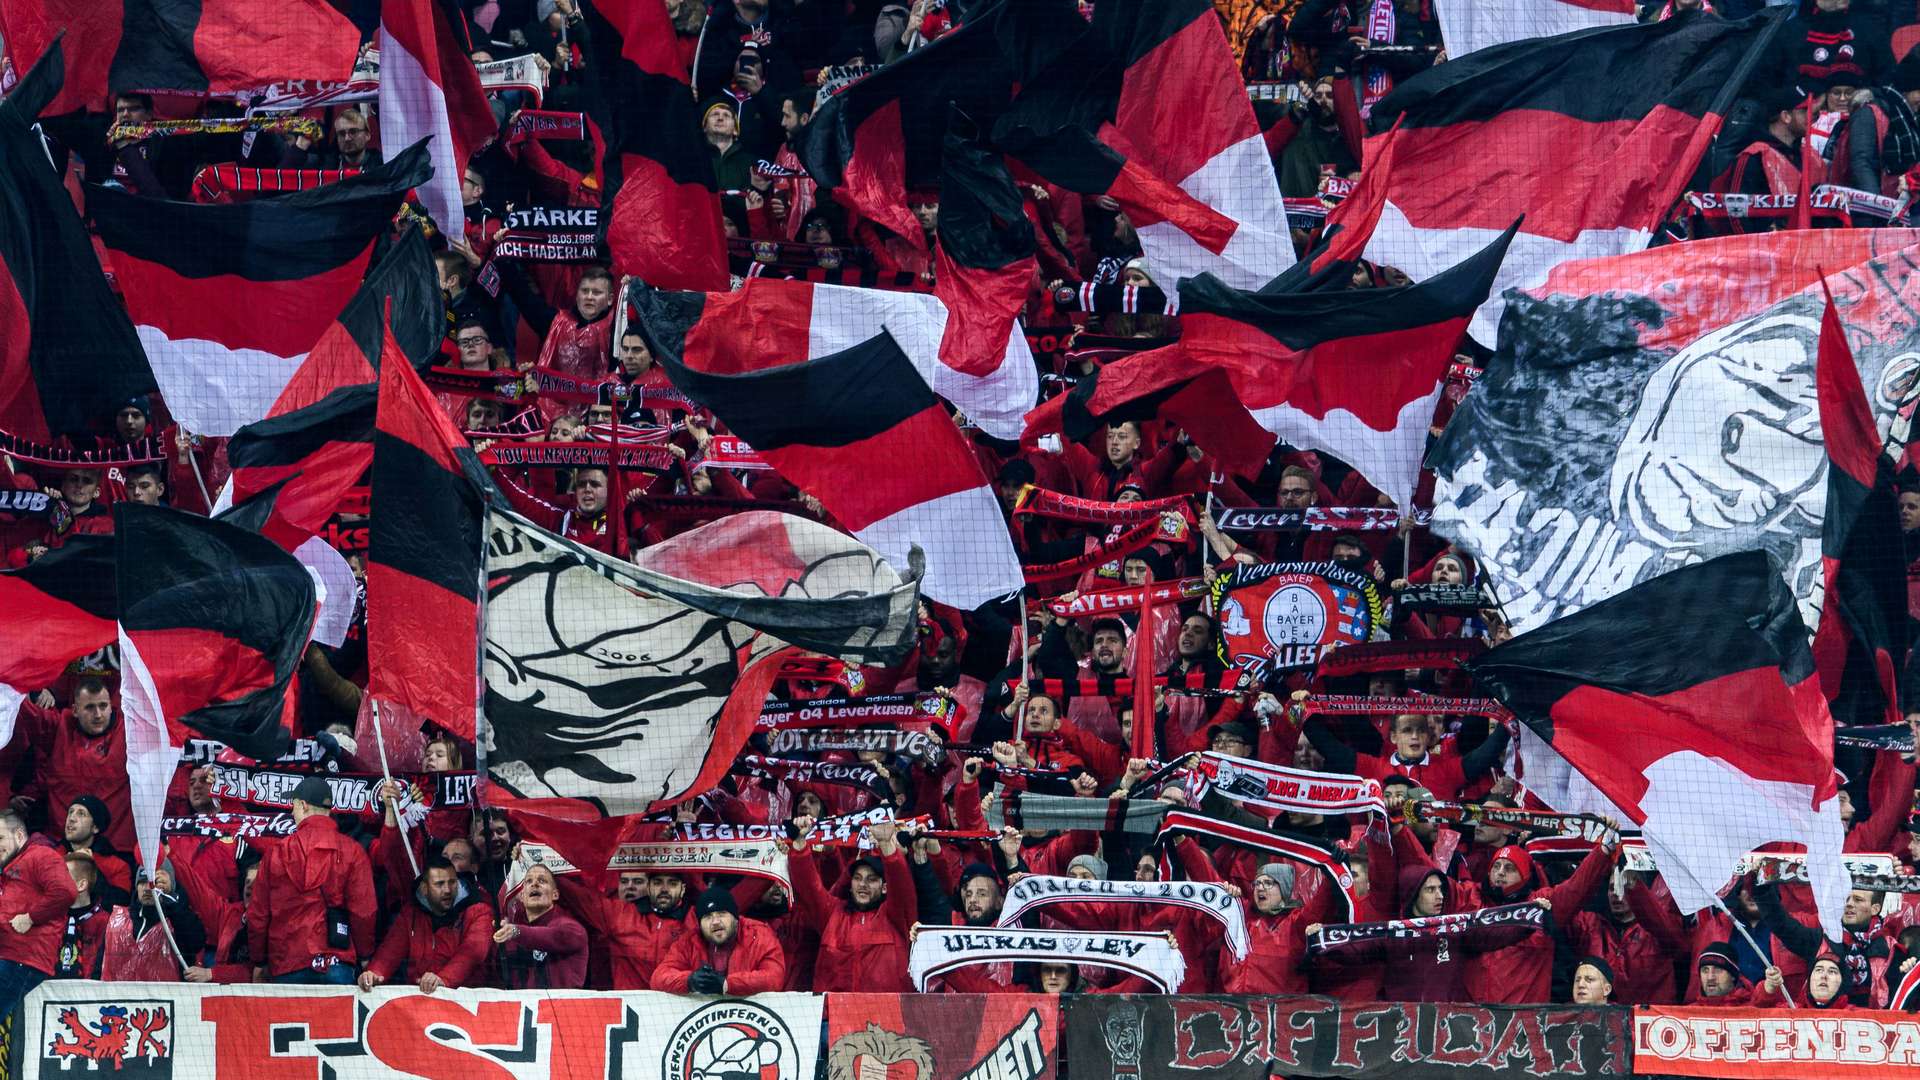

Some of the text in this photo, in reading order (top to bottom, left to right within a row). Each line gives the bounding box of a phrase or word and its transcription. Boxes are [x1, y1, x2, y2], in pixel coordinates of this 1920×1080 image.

[508, 207, 598, 228] STÄRKE
[720, 441, 736, 454] SL
[591, 449, 632, 465] WAK
[1279, 574, 1313, 586] BAYER
[1277, 615, 1314, 625] BAYER
[599, 648, 652, 662] 2006
[800, 708, 824, 721] 04
[828, 704, 914, 719] Leverkusen
[683, 823, 787, 841] LEGION
[1158, 883, 1234, 911] 2009
[942, 934, 1148, 958] ULTRAS LEV
